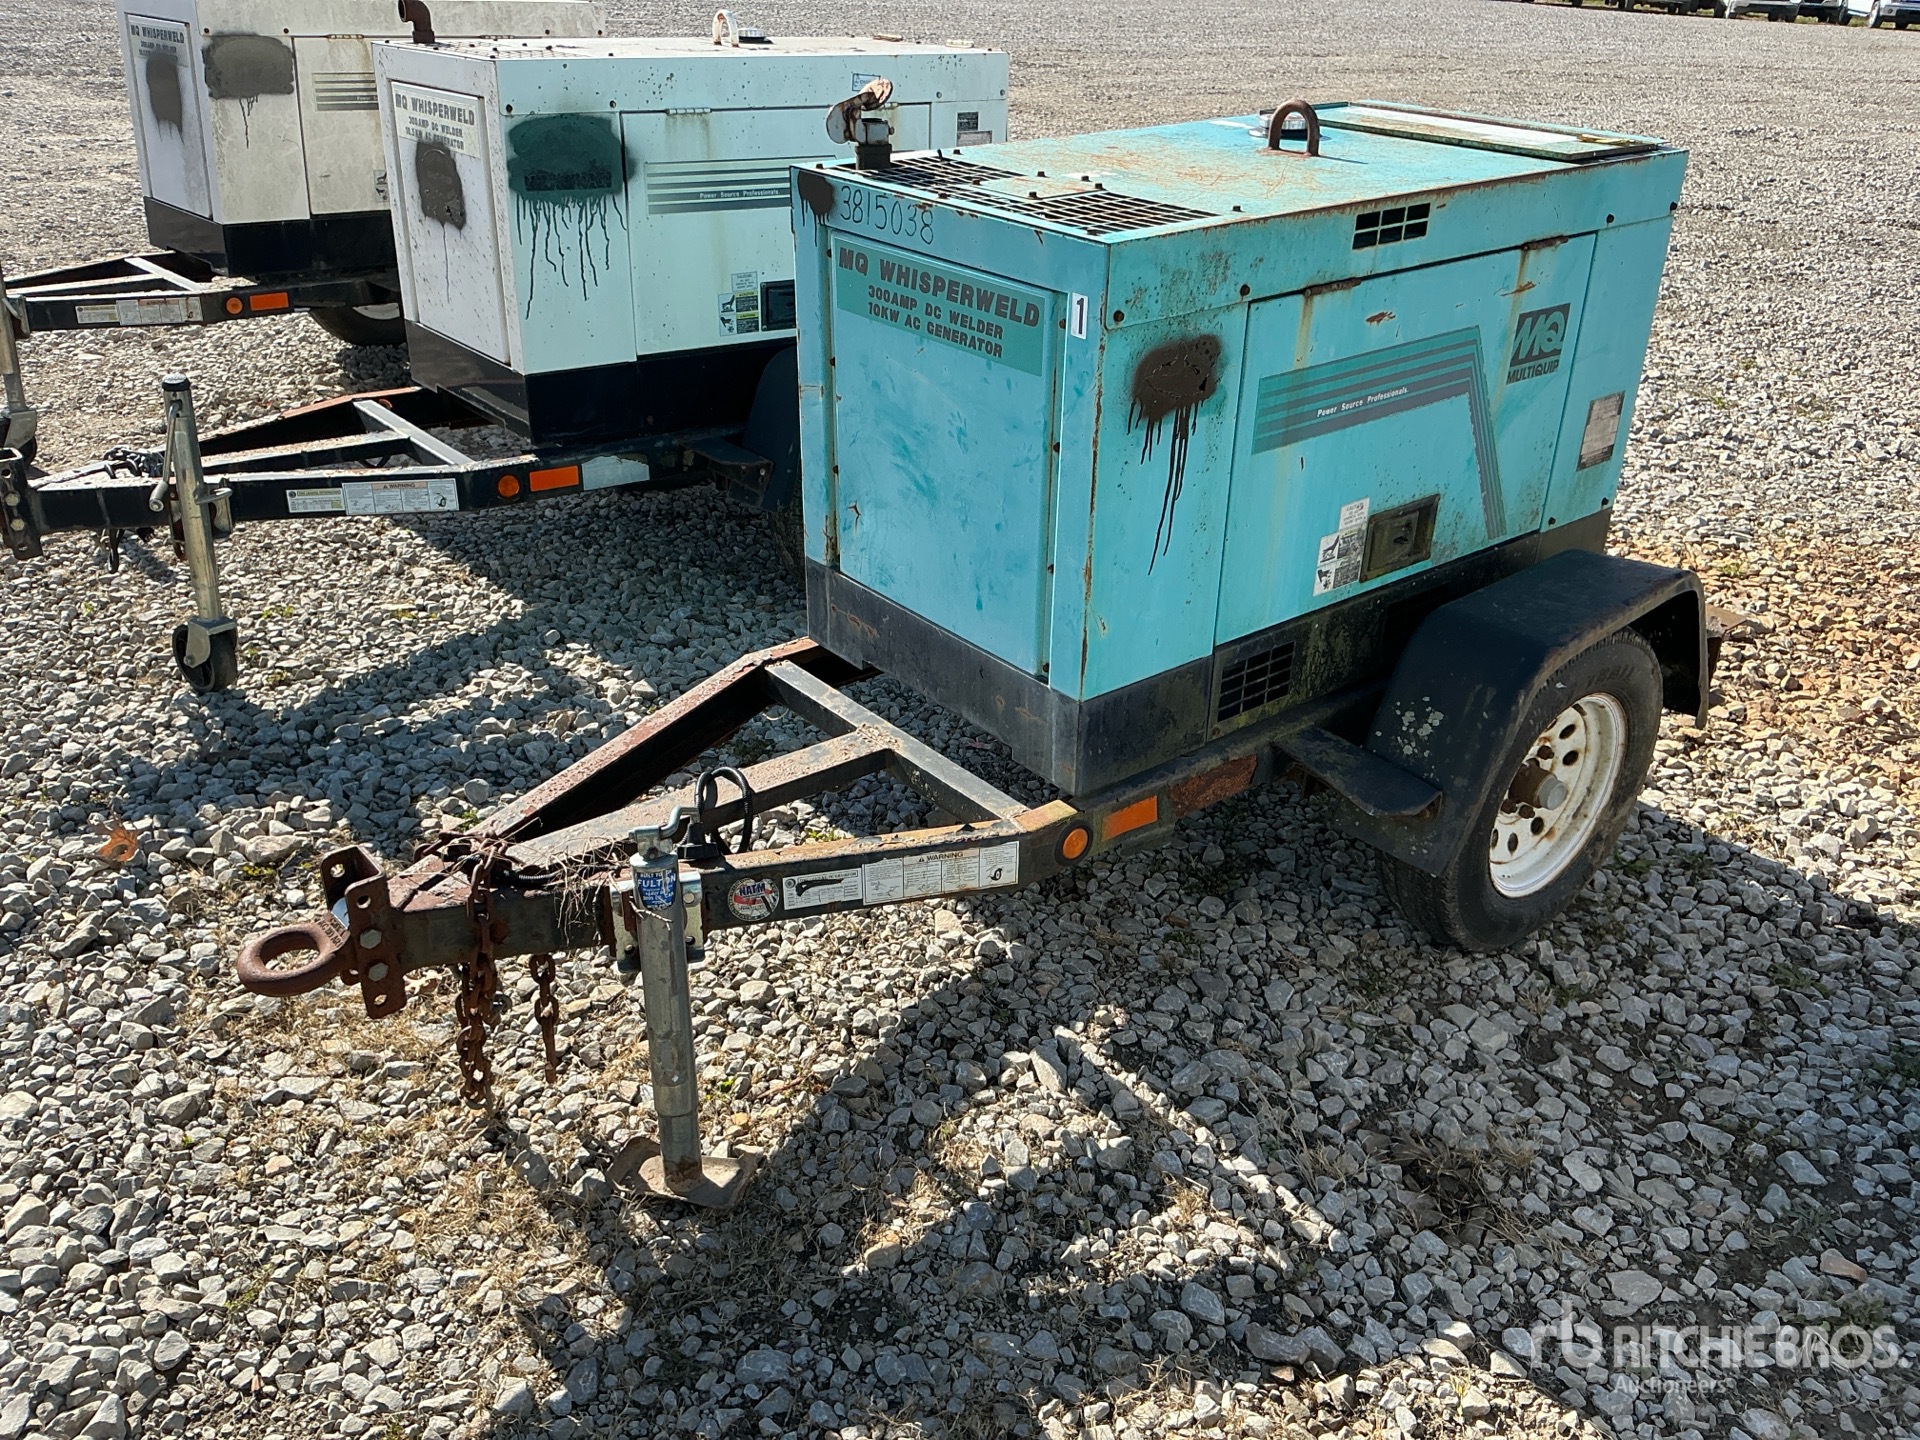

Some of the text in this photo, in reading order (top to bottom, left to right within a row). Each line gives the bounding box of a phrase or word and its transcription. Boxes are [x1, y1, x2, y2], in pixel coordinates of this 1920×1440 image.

[395, 93, 475, 126] MQ WHISPERWELD
[408, 115, 430, 129] 300AMP
[441, 124, 464, 138] WELDER
[840, 185, 934, 246] 3815038
[838, 247, 1040, 328] MQ WHISPERWELD
[867, 285, 1003, 340] 300AMP DC WELDER
[867, 301, 1003, 359] 10KW AC GENERATOR
[1075, 296, 1085, 335] 1
[1510, 310, 1565, 360] MQ
[1505, 359, 1560, 386] MULTIQUIP
[1317, 405, 1338, 418] Power
[1341, 399, 1363, 411] Source
[926, 851, 964, 862] WARNING
[739, 882, 766, 897] NATM
